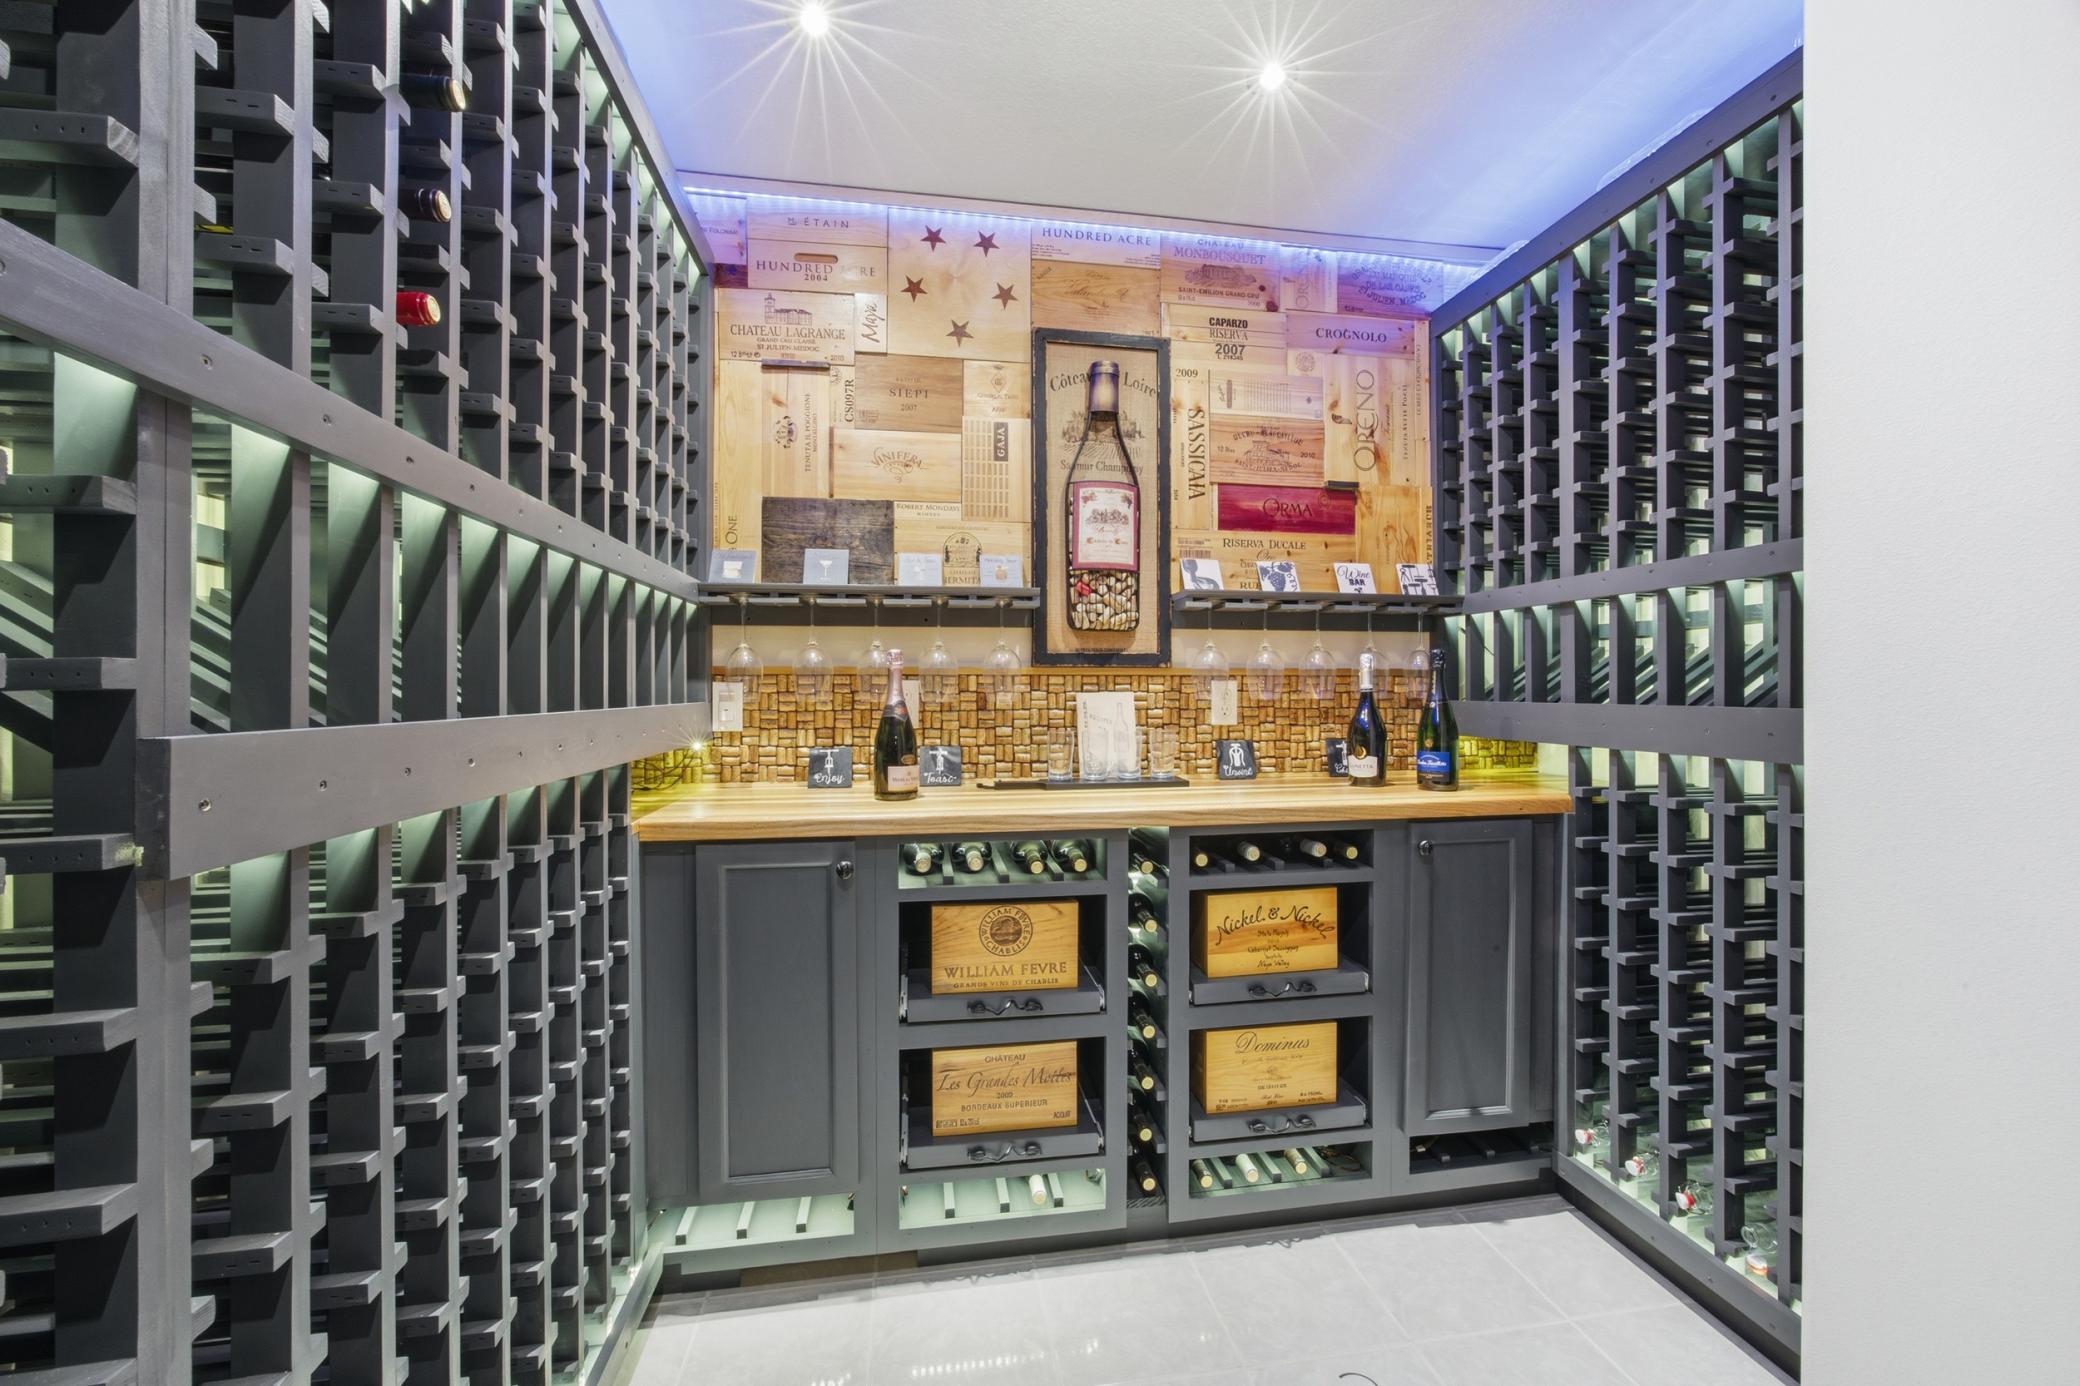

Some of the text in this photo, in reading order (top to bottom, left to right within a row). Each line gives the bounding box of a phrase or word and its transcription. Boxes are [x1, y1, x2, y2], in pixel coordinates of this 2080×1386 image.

[1042, 227, 1152, 246] HUNDRED ACRE
[1174, 246, 1266, 265] MONBOUSQUET
[756, 260, 876, 277] HUNDRED RE
[804, 273, 829, 282] 2004
[1208, 317, 1248, 329] CAPARZO
[730, 324, 846, 340] CHATEAU LAGRANGE
[1209, 328, 1248, 341] RISERVA
[1315, 327, 1387, 343] CROGNOLO
[1215, 343, 1246, 355] 2007
[1176, 368, 1199, 378] 2009
[1124, 371, 1157, 397] Loire
[844, 379, 855, 423] CS097R
[889, 387, 929, 399] SIEPI
[1353, 369, 1379, 472] ORENO
[996, 427, 1006, 457] GAJA
[870, 448, 923, 469] VINIFERA
[1187, 408, 1206, 500] SASSICAIA
[1060, 459, 1095, 471] Samur
[896, 502, 924, 511] ROBERT
[1263, 497, 1313, 518] ORMA
[725, 515, 738, 545] ONE
[1223, 537, 1264, 549] RISERVA
[1269, 539, 1307, 550] DUCALE
[1336, 565, 1370, 579] Wine
[813, 772, 844, 785] Enjoy
[1222, 765, 1253, 777] Unwind
[981, 907, 1013, 937] WILLIAM
[1215, 905, 1336, 946] Nickel & Nickel
[986, 940, 1026, 955] CHABLIS
[944, 961, 1067, 979] WILLIAM FEVRE
[953, 981, 988, 989] GRANDS
[1234, 1031, 1310, 1054] Dominus
[936, 1073, 961, 1092] Les
[967, 1062, 1019, 1098] Grandes
[961, 1103, 1002, 1112] BORDEAUX
